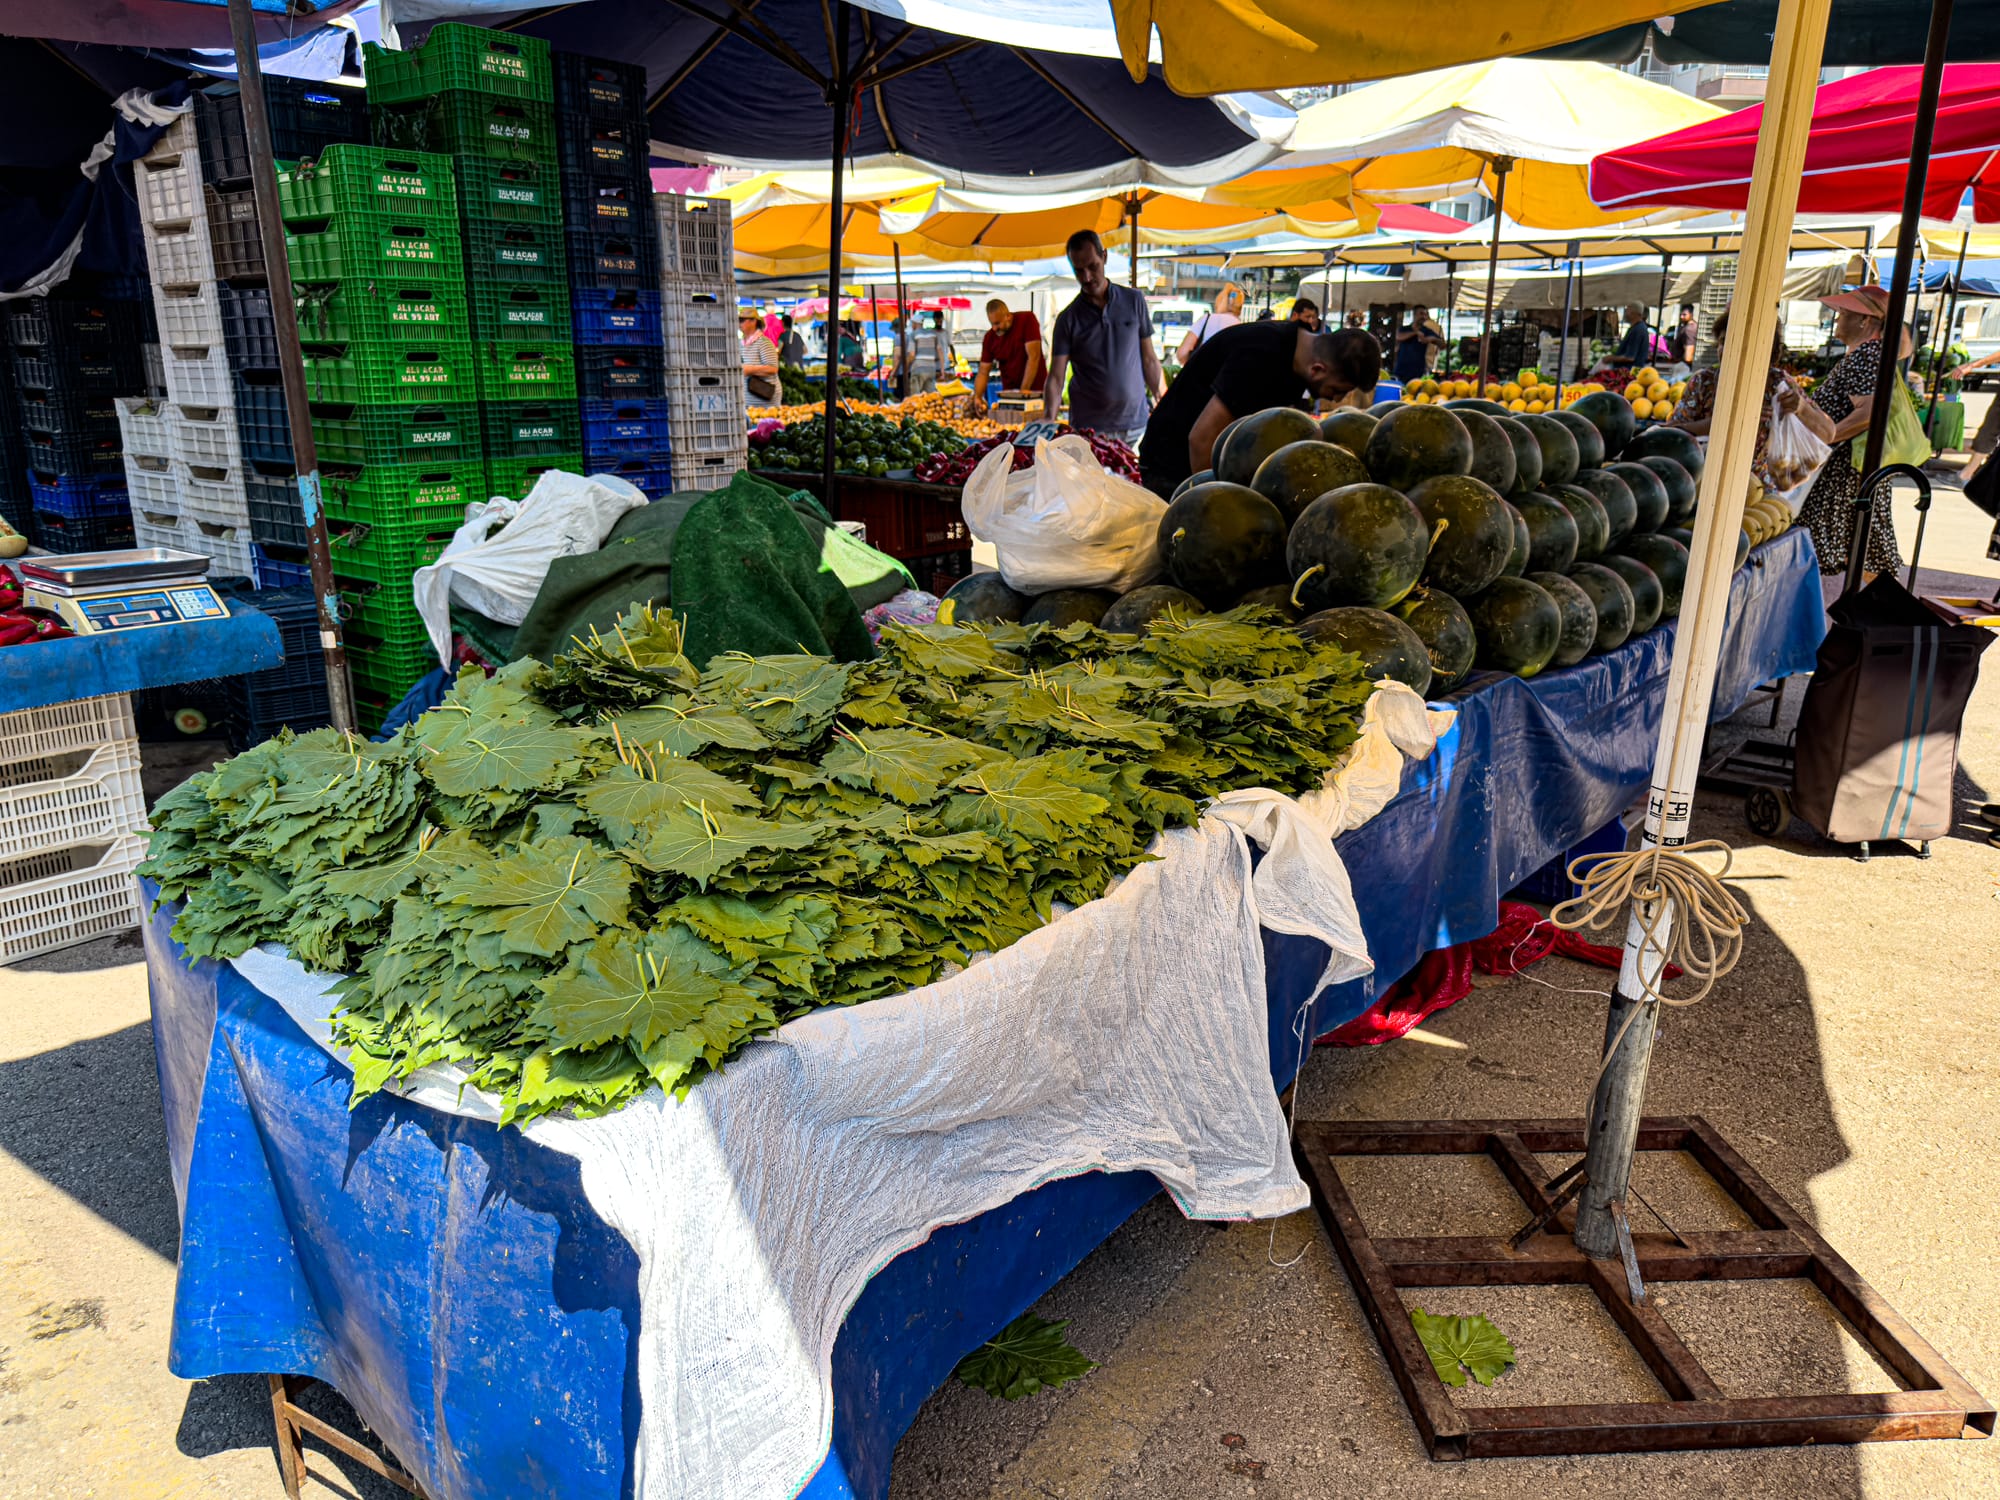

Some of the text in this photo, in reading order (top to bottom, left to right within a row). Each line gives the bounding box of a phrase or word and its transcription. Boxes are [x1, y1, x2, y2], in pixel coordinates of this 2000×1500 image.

[502, 58, 522, 68] ACAR
[400, 176, 422, 186] ACAR
[409, 241, 429, 250] ACAR
[414, 304, 436, 312] ACAR
[1566, 391, 1582, 402] 50
[1018, 424, 1055, 444] 25
